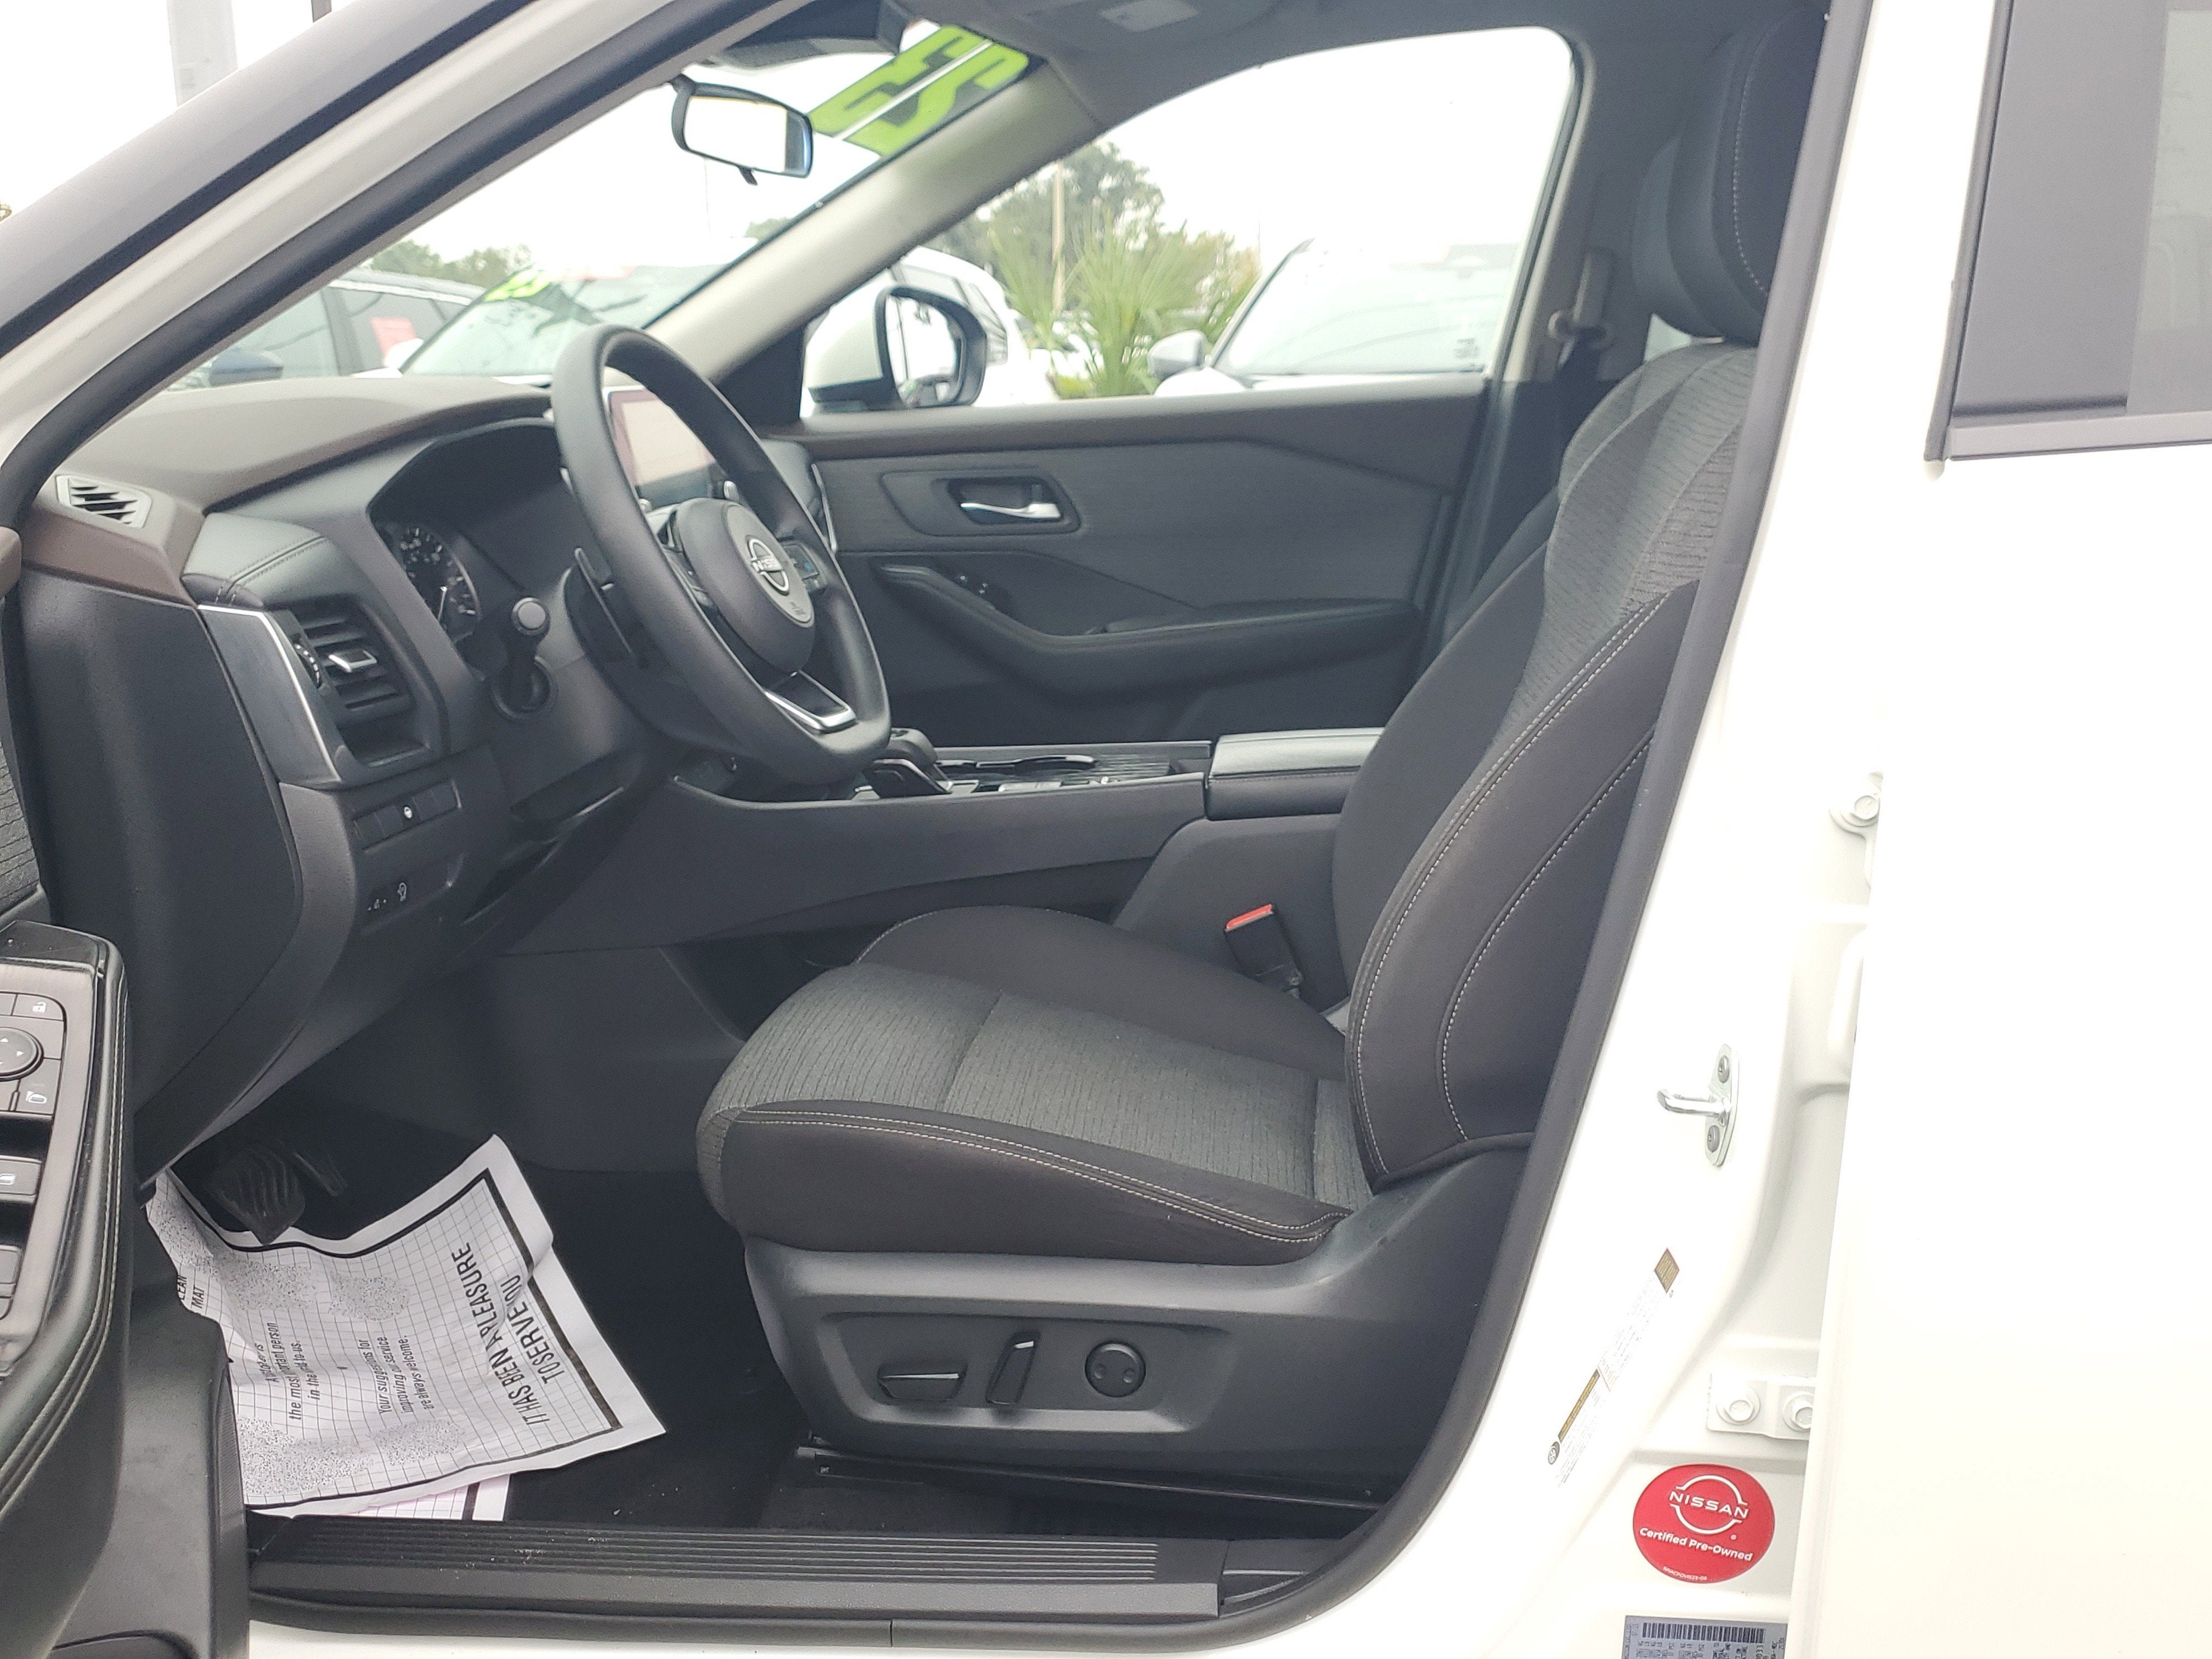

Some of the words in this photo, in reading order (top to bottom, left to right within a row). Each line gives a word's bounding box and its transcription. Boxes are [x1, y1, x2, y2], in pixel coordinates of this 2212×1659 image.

[177, 1275, 187, 1300] LEAN
[191, 1286, 205, 1309] MAT
[451, 1243, 499, 1337] PLEASURE
[500, 1274, 523, 1305] OU
[267, 1323, 286, 1349] person
[358, 1339, 371, 1350] for
[486, 1335, 504, 1351] A
[506, 1302, 554, 1365] SERVE
[255, 1343, 264, 1351] is
[290, 1340, 302, 1352] us.
[376, 1337, 395, 1363] service
[363, 1352, 388, 1392] suggesons
[488, 1347, 525, 1387] BEEN
[538, 1362, 565, 1384] TO
[285, 1375, 300, 1398] most
[305, 1374, 319, 1386] the
[410, 1370, 428, 1398] always
[308, 1389, 320, 1400] in
[378, 1395, 392, 1413] Your
[393, 1374, 414, 1414] improving
[420, 1400, 435, 1409] are
[508, 1385, 542, 1413] HAS
[288, 1402, 302, 1420] the
[522, 1413, 550, 1425] IT
[1669, 1491, 1749, 1519] NISSAN
[1639, 1527, 1687, 1546] Certified
[1689, 1539, 1754, 1562] Pre-Owned
